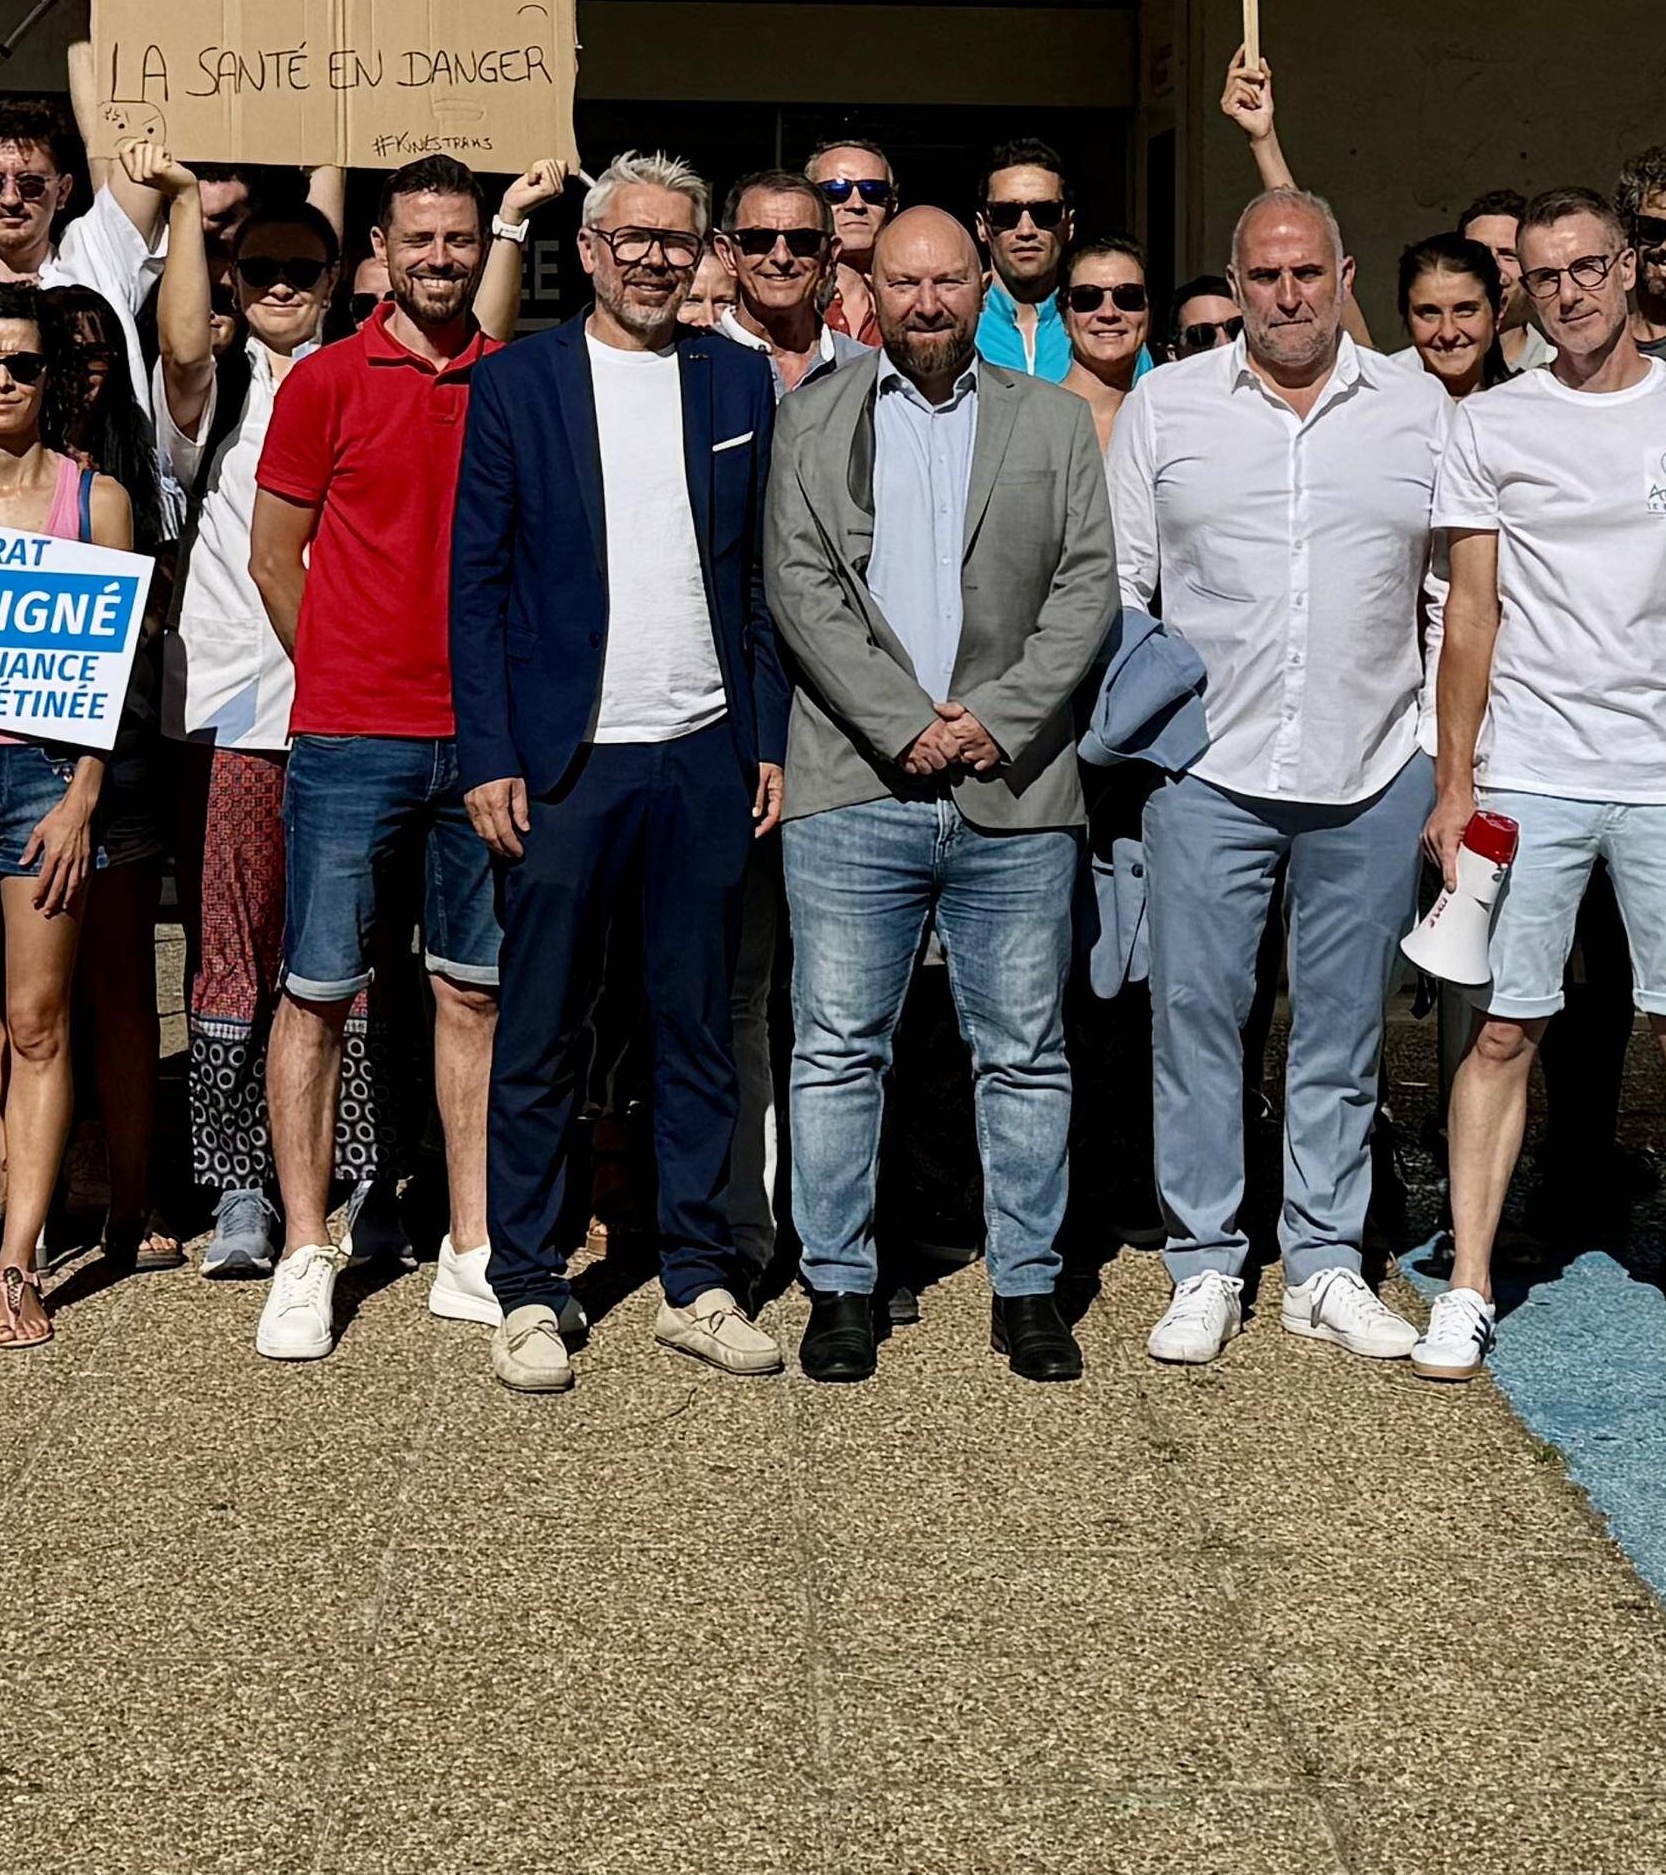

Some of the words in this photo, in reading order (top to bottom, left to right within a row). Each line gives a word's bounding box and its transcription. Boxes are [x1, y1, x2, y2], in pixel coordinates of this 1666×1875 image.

[109, 41, 170, 104] LA
[185, 41, 310, 97] SANTÉ
[328, 47, 384, 89] EN
[396, 44, 553, 88] DANGER
